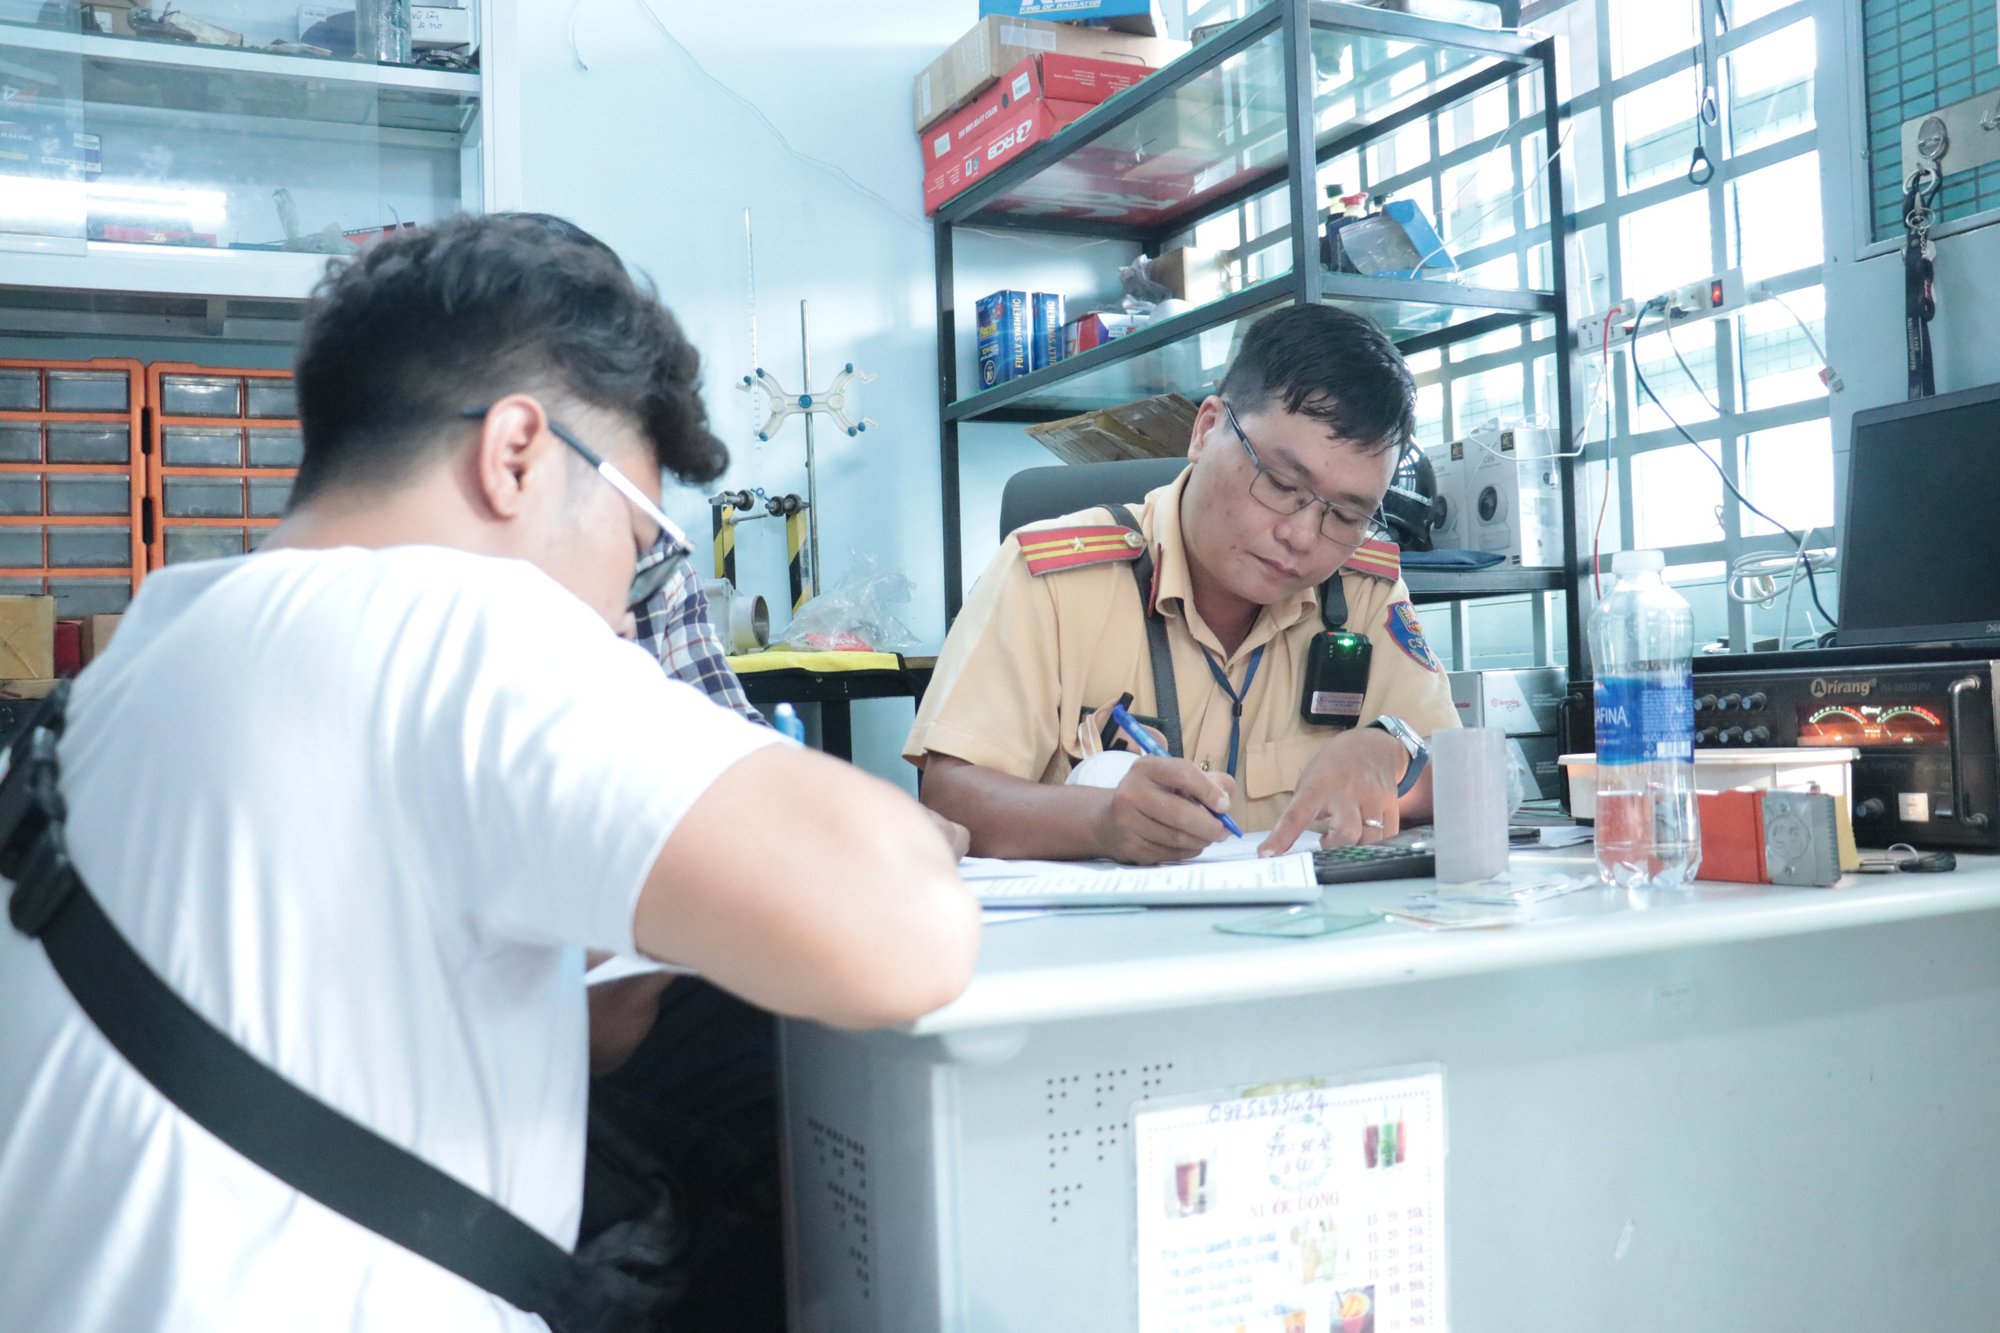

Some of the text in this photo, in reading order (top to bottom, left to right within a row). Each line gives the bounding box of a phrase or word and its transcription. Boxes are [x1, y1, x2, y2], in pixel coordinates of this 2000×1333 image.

[1020, 4, 1041, 13] KING
[987, 133, 1016, 161] RCB
[1012, 298, 1024, 369] FULLY SYNTHETIC
[1046, 300, 1056, 346] SYNTHETIC
[1810, 677, 1871, 698] Arirang
